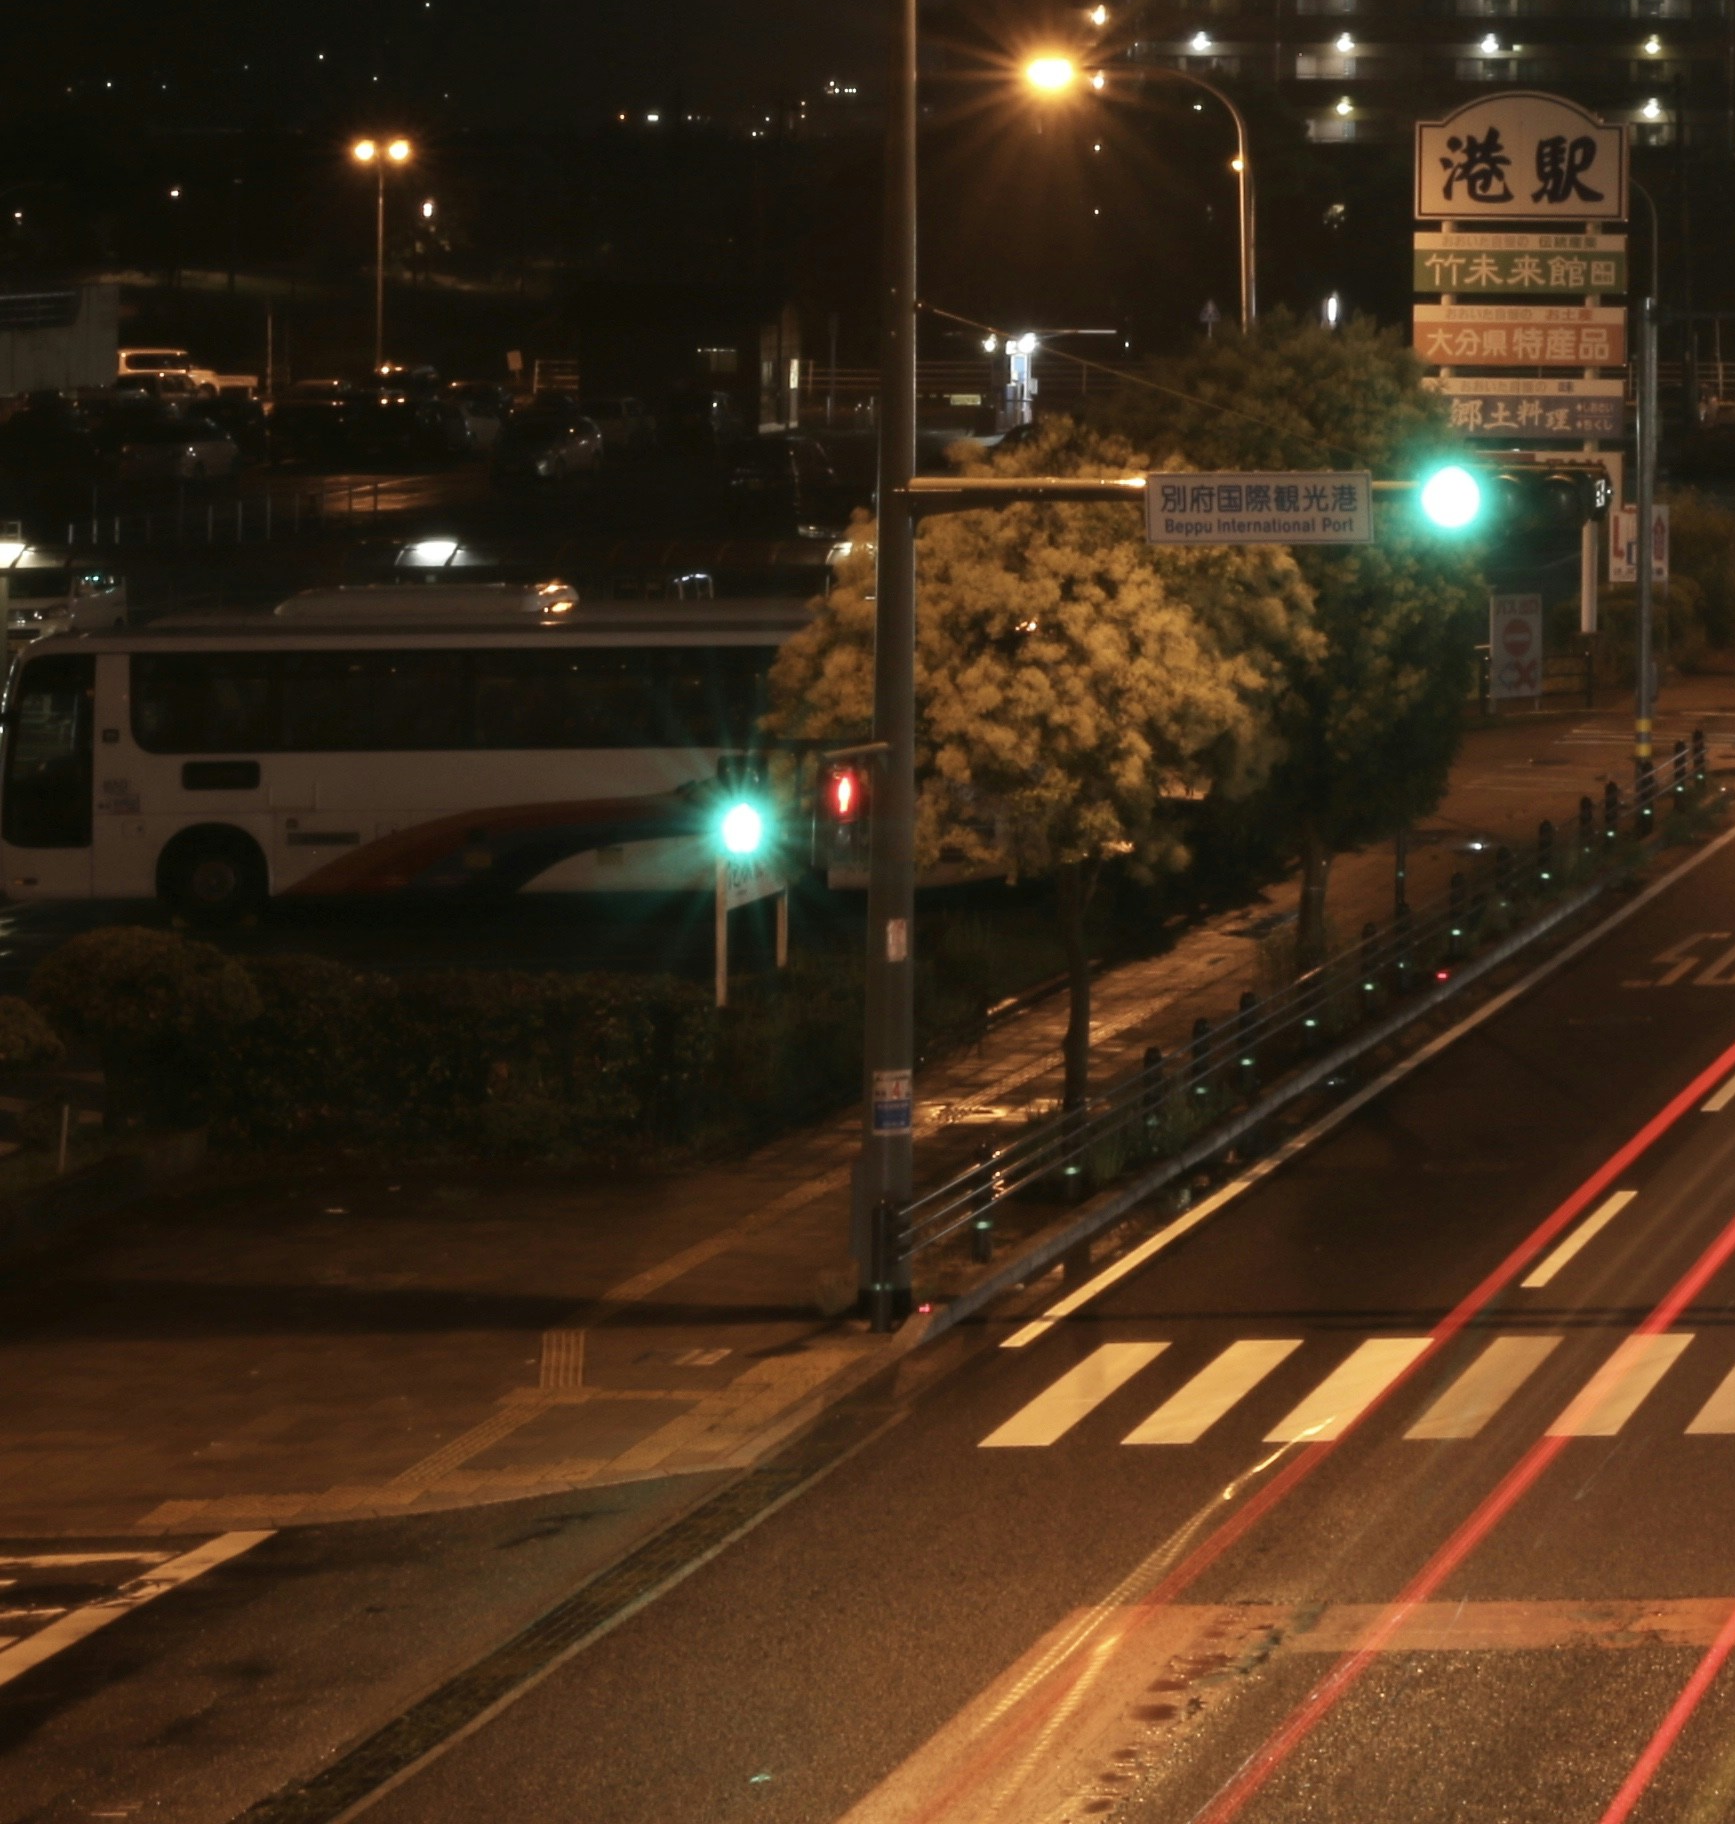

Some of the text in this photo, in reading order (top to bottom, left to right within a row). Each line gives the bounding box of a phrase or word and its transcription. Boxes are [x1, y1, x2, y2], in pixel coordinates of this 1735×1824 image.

[1439, 126, 1604, 204] 港駅
[1424, 253, 1588, 288] 竹未来館
[1426, 327, 1609, 360] 大分県特産品
[1448, 397, 1573, 432] 郷土料理
[1160, 484, 1358, 514] 別府国際観光港
[1164, 517, 1355, 536] Beppu International Port
